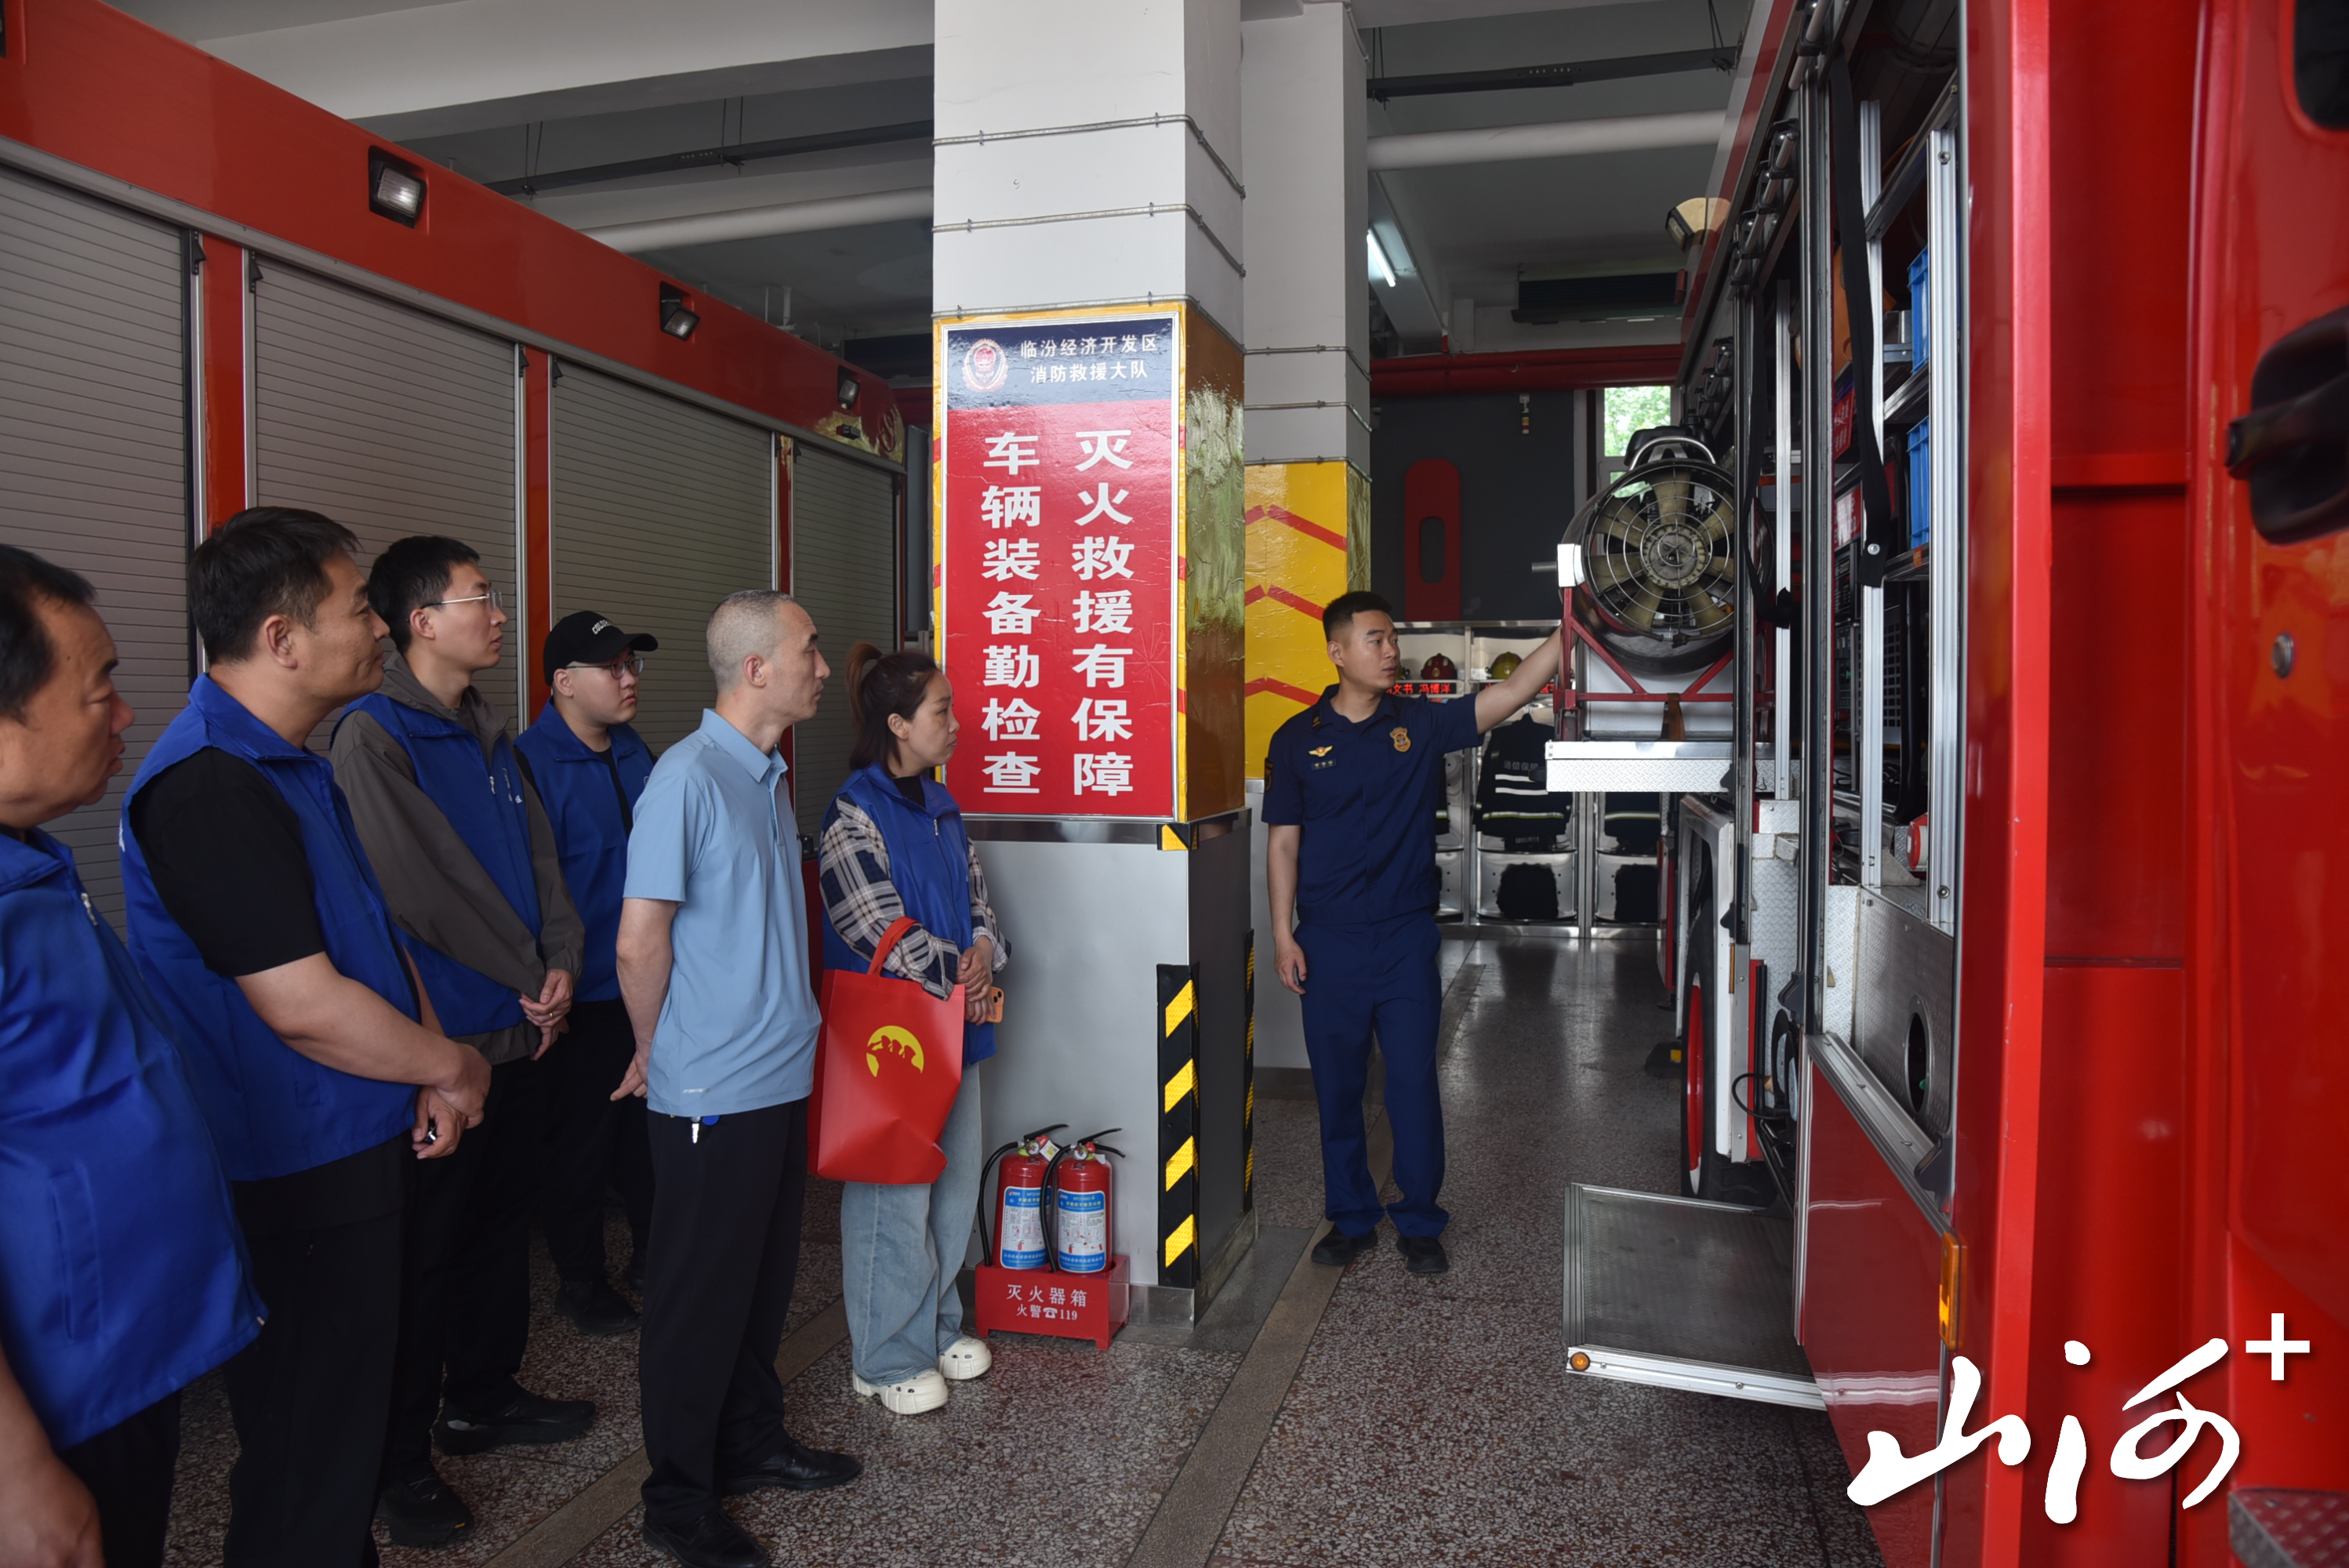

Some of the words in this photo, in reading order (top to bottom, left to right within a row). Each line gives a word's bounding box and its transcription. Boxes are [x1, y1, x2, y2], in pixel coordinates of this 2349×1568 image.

[1020, 333, 1159, 358] 临汾经济开发区
[1030, 360, 1148, 383] 消防救援大队
[981, 431, 1042, 793] 车辆装备勤检查
[1071, 429, 1135, 796] 灭火救援有保障
[1006, 1284, 1087, 1308] 灭火器箱
[1016, 1303, 1041, 1319] 火警
[1060, 1308, 1078, 1321] 119
